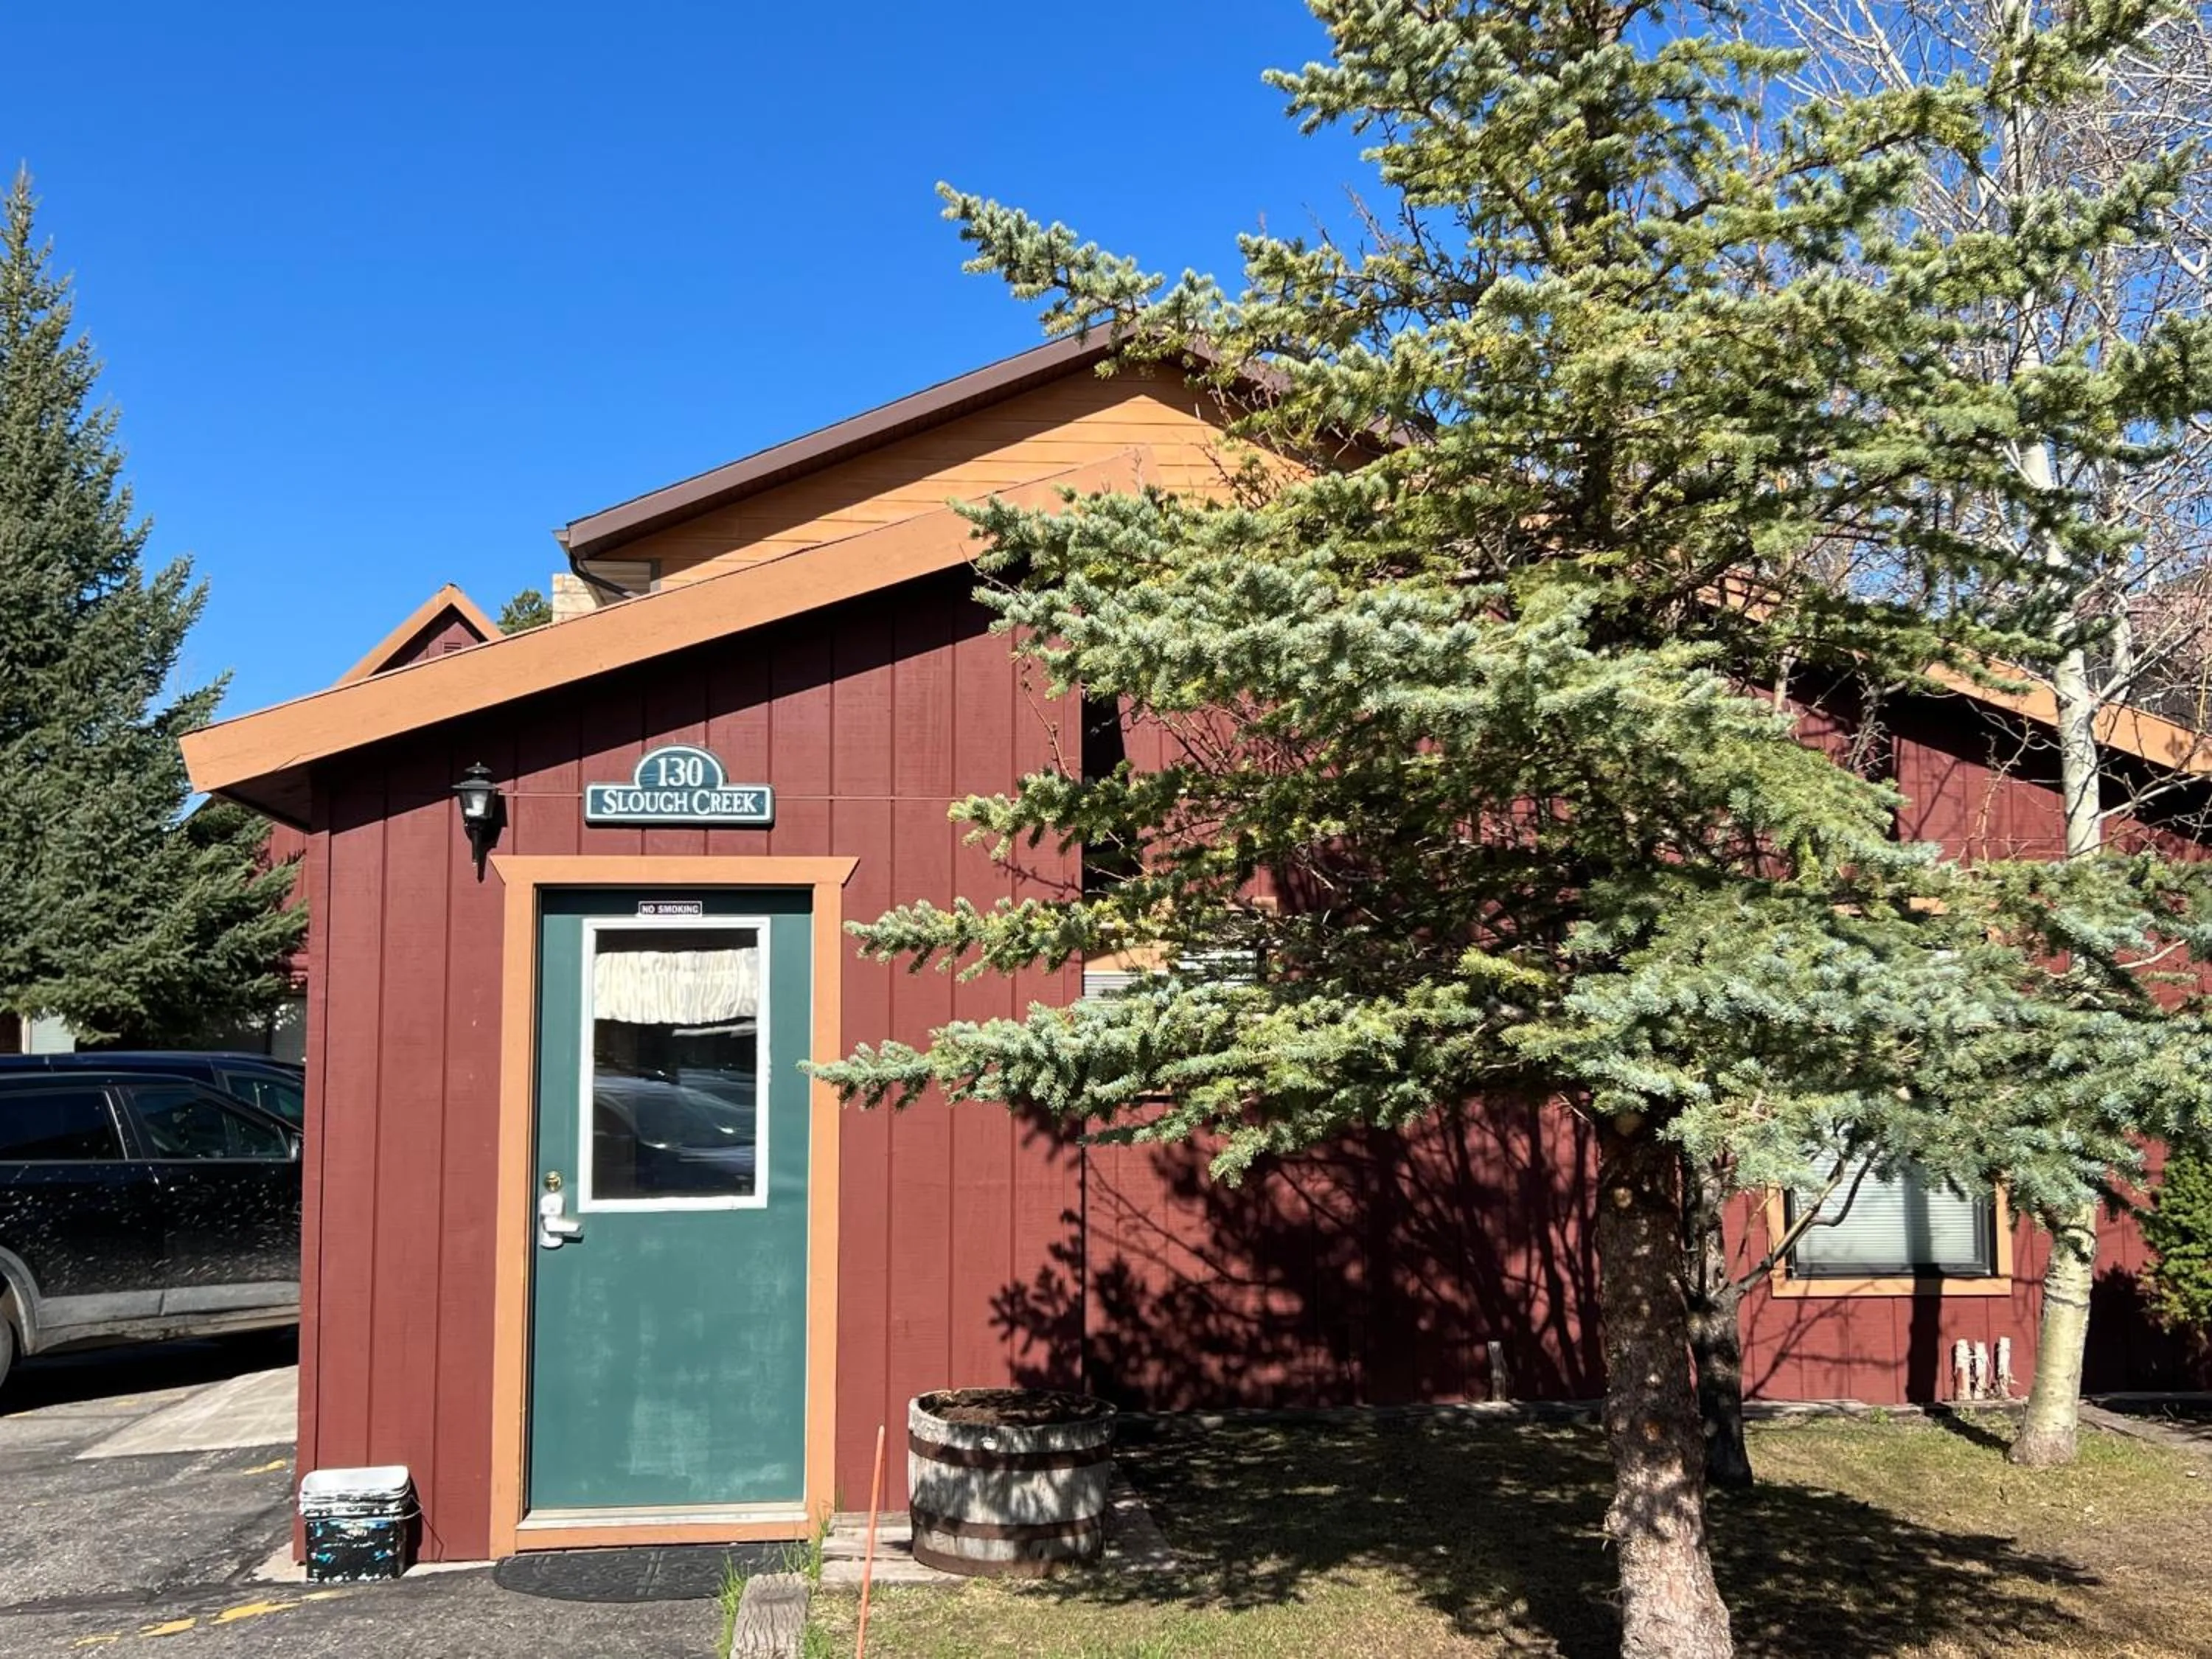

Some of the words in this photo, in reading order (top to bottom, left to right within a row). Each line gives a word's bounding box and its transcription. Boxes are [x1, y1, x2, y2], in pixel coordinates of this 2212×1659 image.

[658, 757, 703, 787] 130
[602, 790, 689, 814] SLOUGH
[692, 790, 757, 815] CREEK
[641, 905, 655, 914] NO
[657, 905, 699, 914] SMOKING
